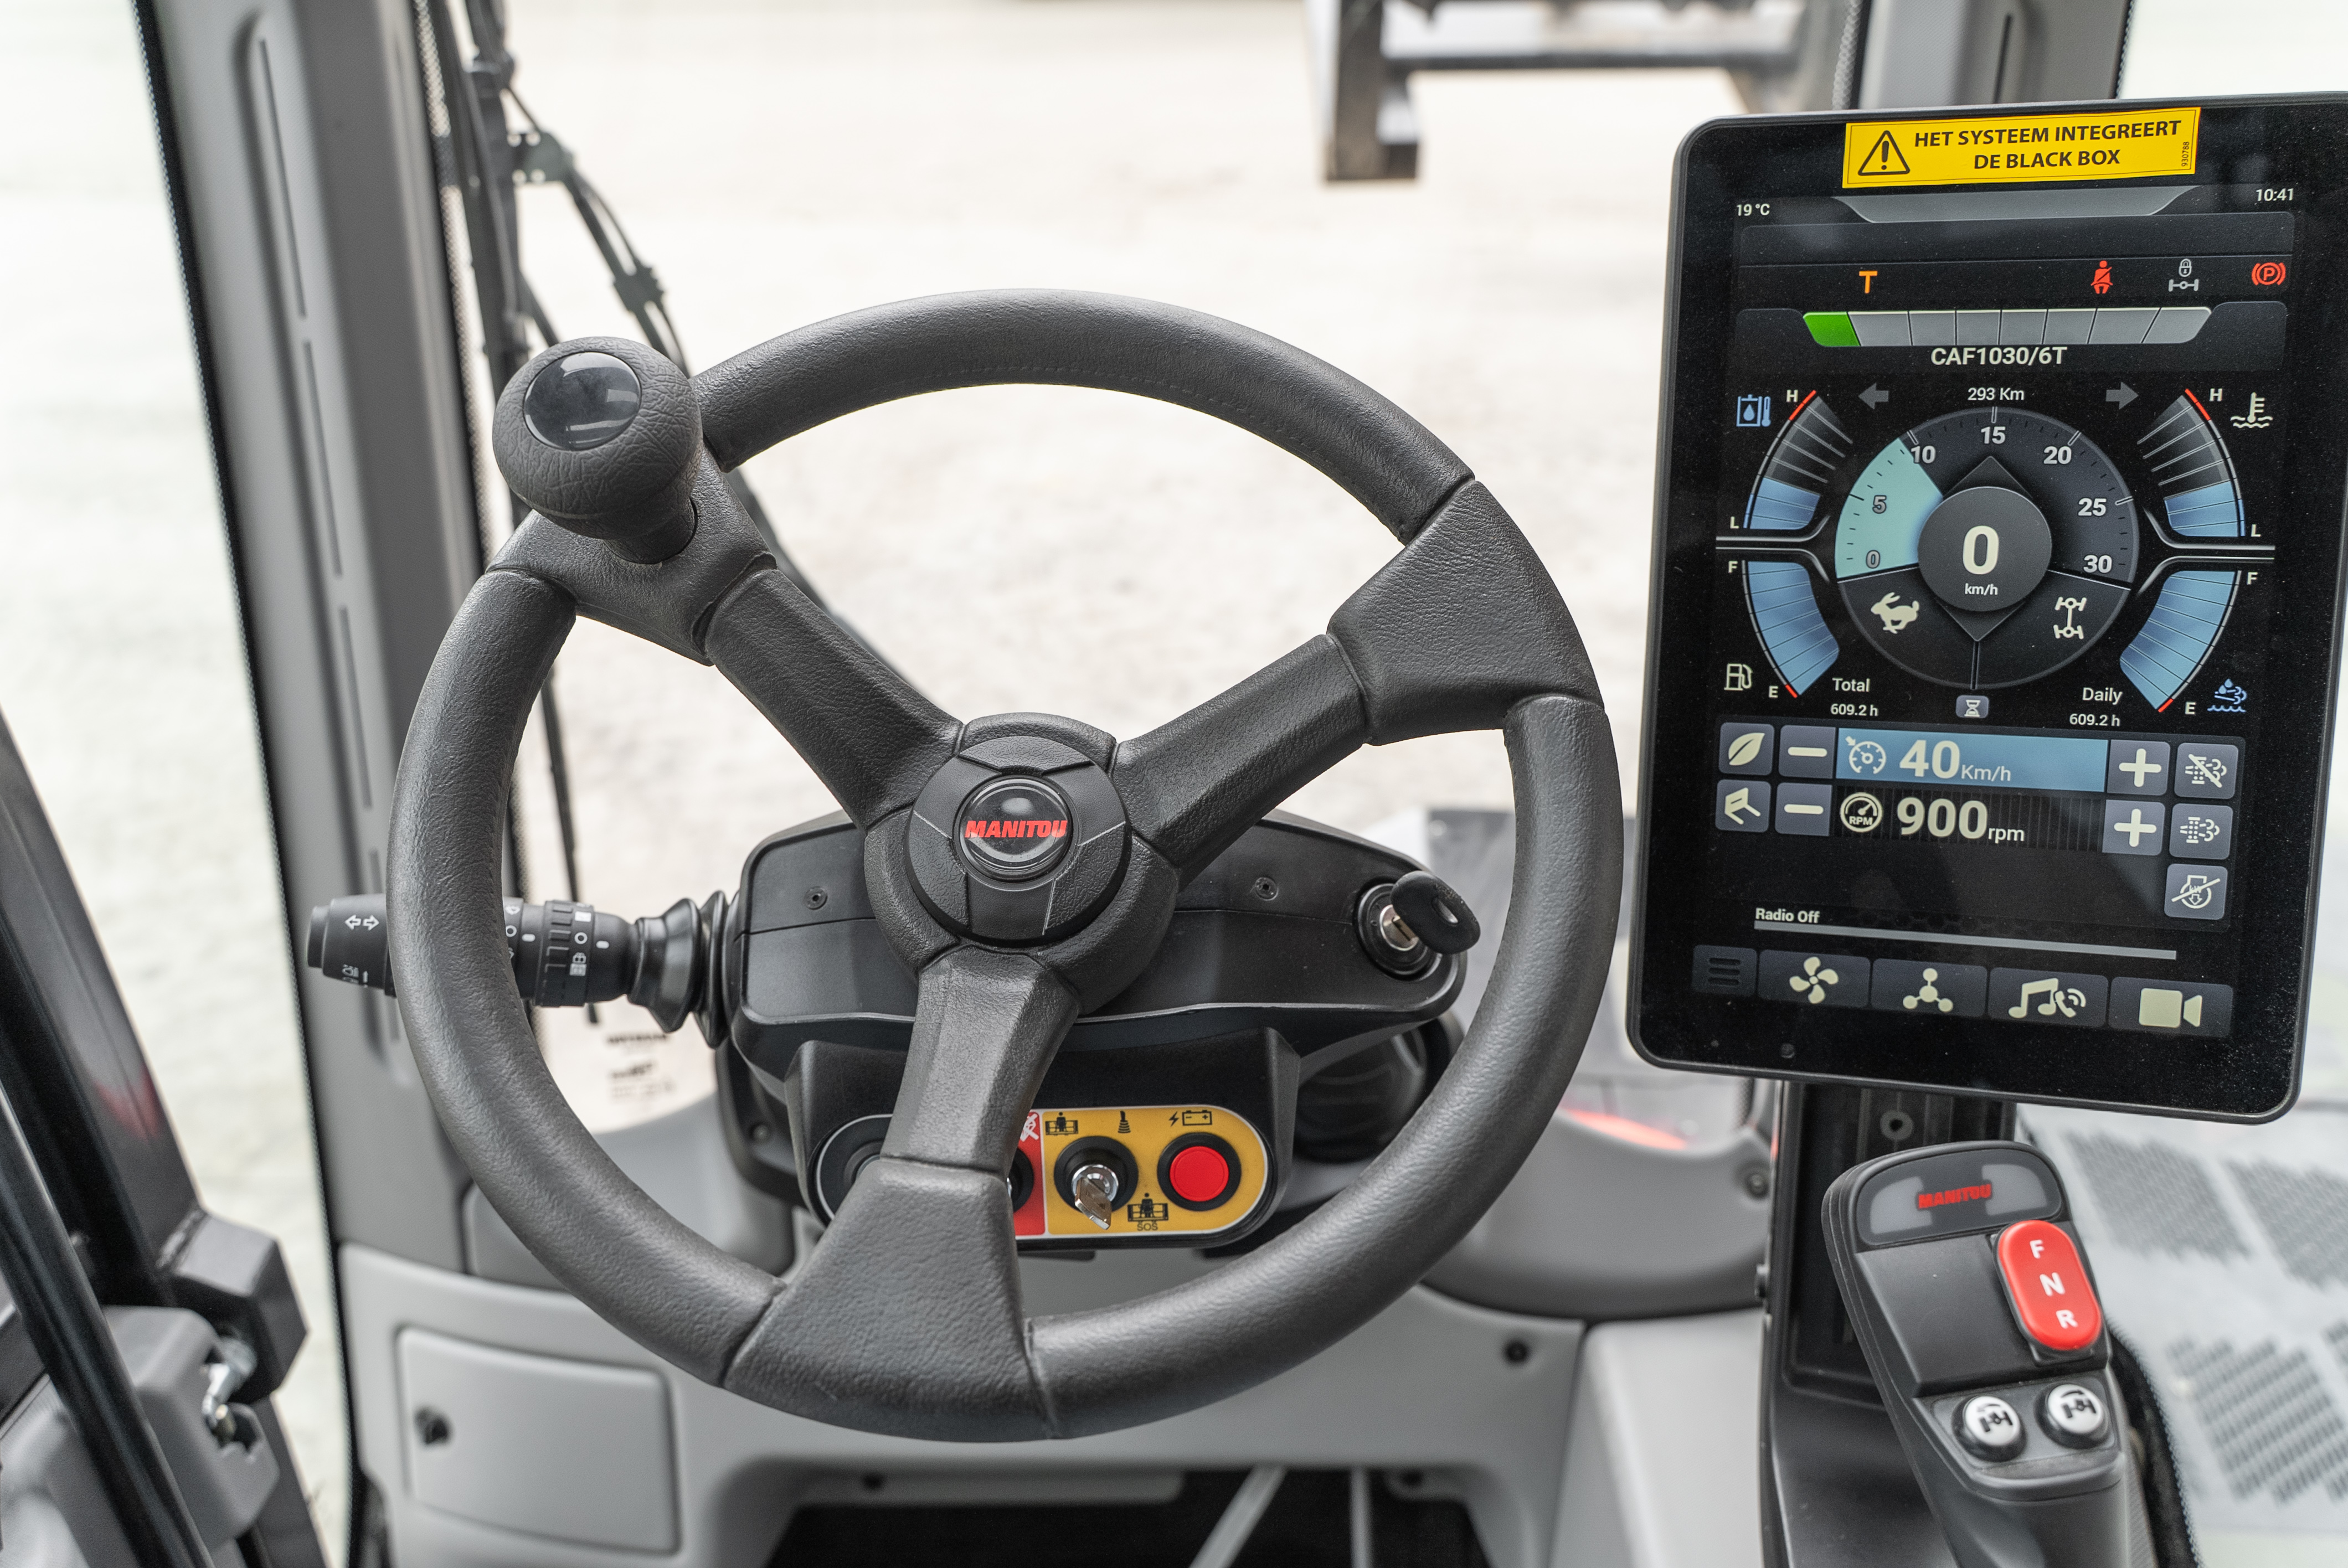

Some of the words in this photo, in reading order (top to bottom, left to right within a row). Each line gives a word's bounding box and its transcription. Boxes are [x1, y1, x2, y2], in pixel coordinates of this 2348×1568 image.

[1915, 132, 1954, 147] HET
[1958, 128, 2048, 145] SYSTEEM
[2056, 121, 2181, 141] INTEGREERT
[1975, 154, 2000, 169] DE
[2007, 152, 2072, 168] BLACK
[2078, 149, 2120, 166] BOX
[2181, 142, 2190, 166] 930788
[2256, 188, 2293, 201] 10:41
[1737, 204, 1752, 216] 19
[1859, 271, 1877, 293] T
[2263, 267, 2275, 281] P
[1931, 347, 2067, 365] CAF1030/6T
[1786, 390, 1798, 402] H
[1968, 388, 1995, 400] 293
[2000, 388, 2024, 400] Km
[2210, 389, 2222, 401] H
[1981, 426, 2005, 443] 15
[1913, 446, 1935, 463] 10
[2044, 446, 2071, 464] 20
[1874, 497, 1886, 513] 5
[2078, 498, 2106, 516] 25
[1731, 517, 1739, 529] L
[2251, 524, 2261, 537] L
[1963, 526, 1999, 574] 0
[1728, 561, 1738, 572] F
[1867, 550, 1880, 568] 0
[2084, 555, 2112, 572] 30
[2247, 572, 2258, 585] F
[1965, 583, 1997, 595] km/h
[1769, 686, 1778, 698] E
[1832, 678, 1870, 692] Total
[2083, 688, 2123, 705] Daily
[1831, 704, 1866, 716] 609.2
[1870, 705, 1877, 716] h
[2185, 702, 2196, 714] E
[2070, 714, 2108, 726] 609.2
[2112, 714, 2120, 726] h
[1899, 740, 1960, 778] 40
[1961, 765, 2011, 781] Km/h
[1848, 817, 1874, 827] RPM
[1897, 797, 1987, 839] 900
[1989, 828, 2024, 843] rpm
[965, 821, 1067, 837] MANITOU
[1755, 908, 1794, 922] Radio
[1798, 911, 1820, 923] Off
[1919, 1184, 1991, 1208] MANITOU
[2030, 1240, 2043, 1258] F
[2040, 1273, 2064, 1296] N
[2056, 1310, 2077, 1328] R
